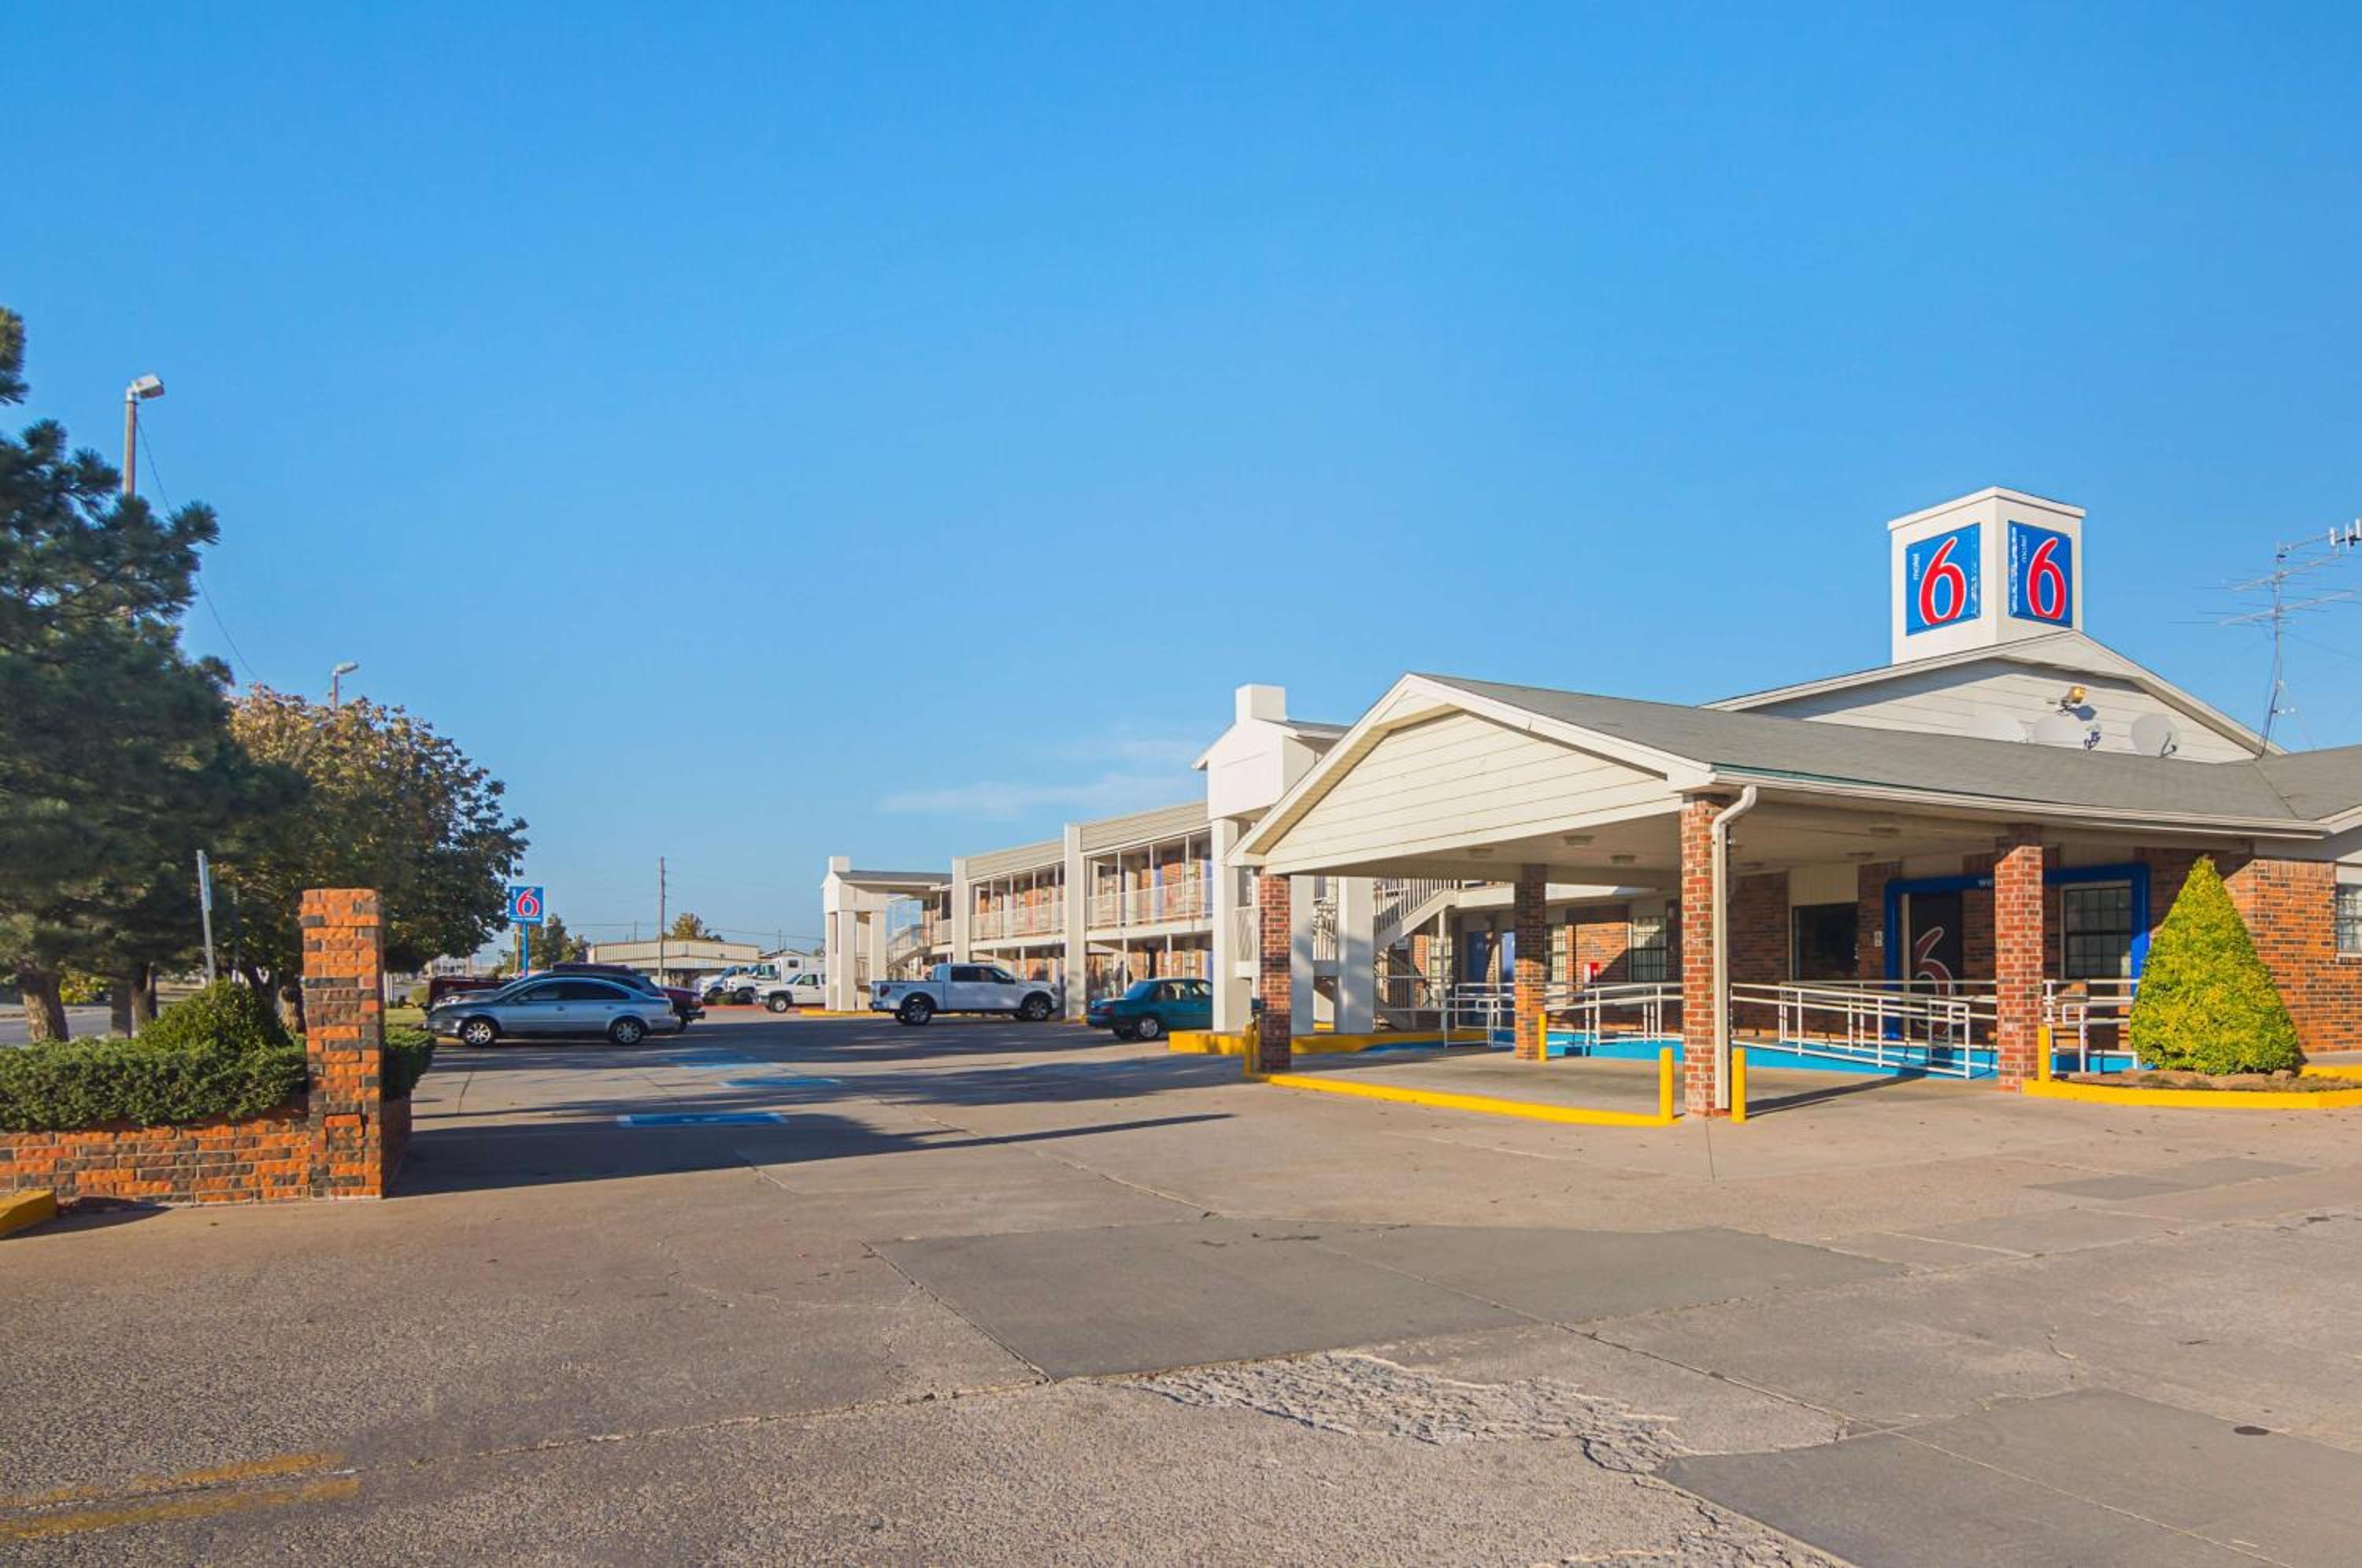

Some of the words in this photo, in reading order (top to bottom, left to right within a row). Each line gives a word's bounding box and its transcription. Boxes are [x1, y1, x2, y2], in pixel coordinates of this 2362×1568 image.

[1919, 536, 1967, 625] 6
[2027, 537, 2066, 620] 6
[516, 887, 539, 916] 6
